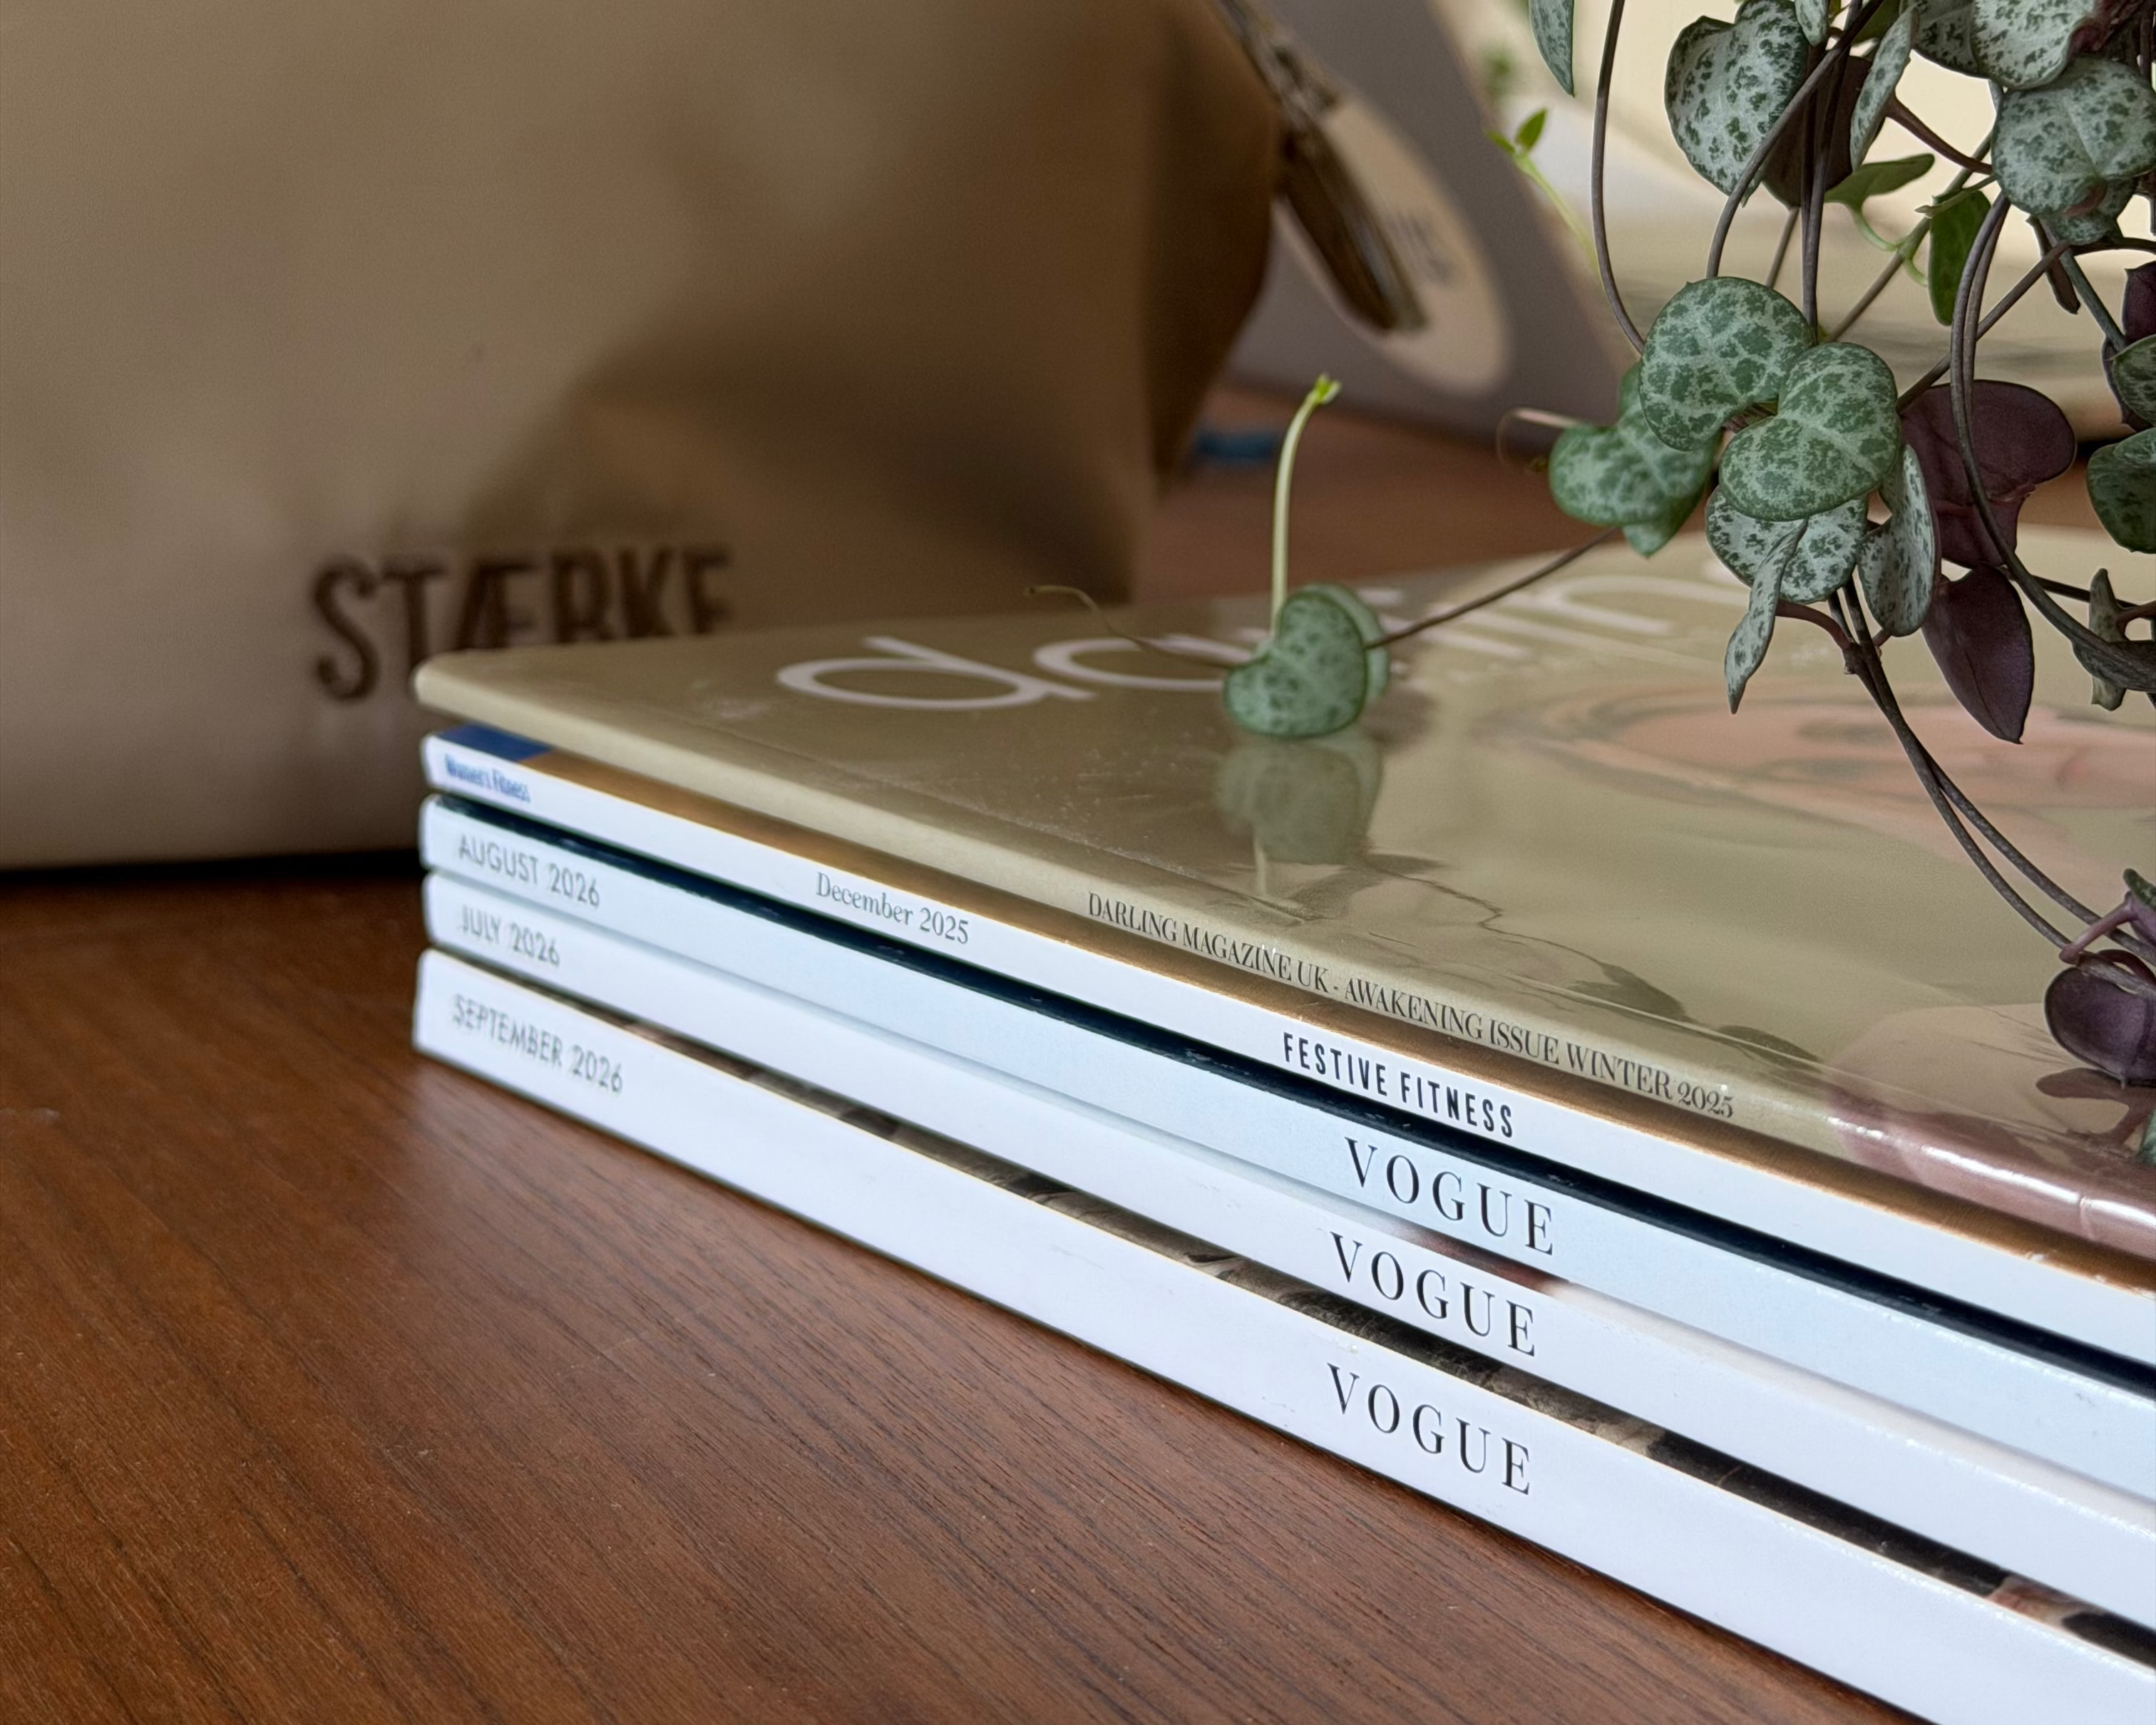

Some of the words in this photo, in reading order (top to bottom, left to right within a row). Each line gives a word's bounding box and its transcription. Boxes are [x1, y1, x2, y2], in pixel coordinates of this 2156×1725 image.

[459, 834, 538, 885] AUGUST
[548, 863, 600, 908] 2026
[816, 872, 913, 926] December
[920, 907, 969, 944] 2025
[459, 905, 500, 944] JULY
[508, 922, 560, 967] 2026
[453, 994, 563, 1067] SEPTEMBER
[570, 1044, 623, 1093] 2026
[1087, 891, 1177, 942] DARLING
[1182, 922, 1292, 981] MAGAZINE
[1297, 959, 1330, 994] UK
[1344, 977, 1483, 1039] AWAKENING
[1489, 1018, 1560, 1064] ISSUE
[1566, 1041, 1673, 1100] WINTER
[1676, 1081, 1734, 1119] 2025
[1283, 1031, 1387, 1096] FESTIVE
[1400, 1071, 1513, 1138] FITNESS
[1344, 1136, 1553, 1255] VOGUE
[1330, 1231, 1535, 1356] VOGUE
[1327, 1362, 1530, 1495] VOGUE
